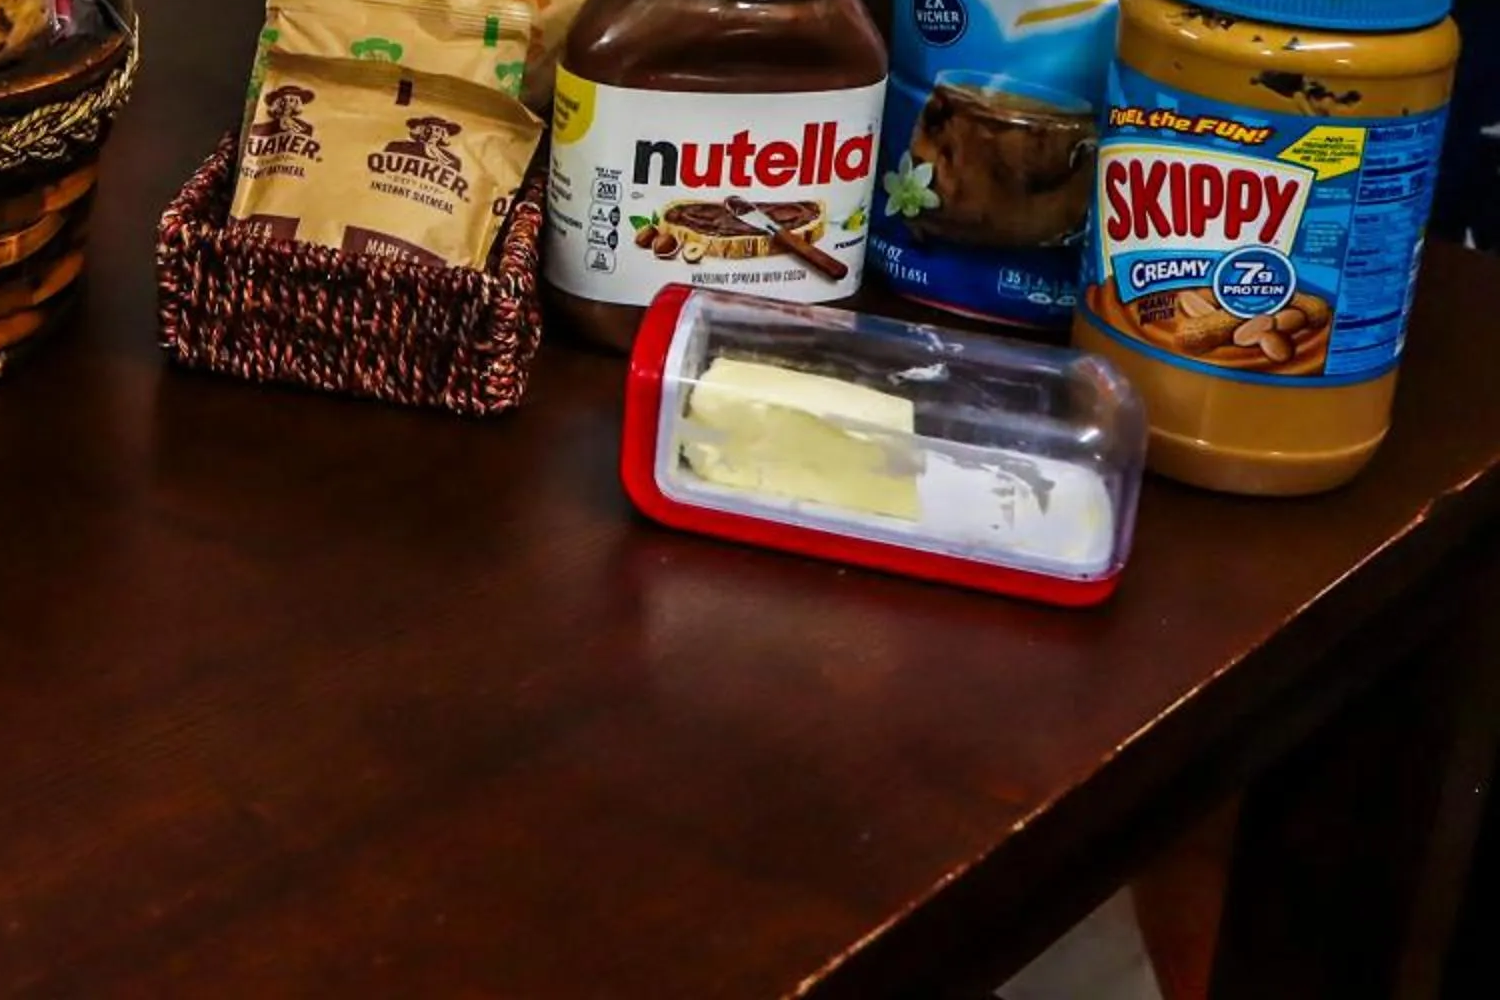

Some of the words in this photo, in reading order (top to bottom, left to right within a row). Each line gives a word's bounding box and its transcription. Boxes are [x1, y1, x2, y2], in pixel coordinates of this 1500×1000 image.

[1109, 108, 1145, 127] FUEL
[1149, 110, 1191, 133] the
[1194, 117, 1273, 145] FUN!
[247, 135, 319, 161] UAKER
[632, 121, 875, 188] nutella
[367, 153, 468, 201] QUAKER
[1105, 158, 1299, 245] SKIPPY
[1132, 260, 1210, 288] CREAMY
[1234, 261, 1273, 285] 7g
[1223, 285, 1285, 295] PROTEIN
